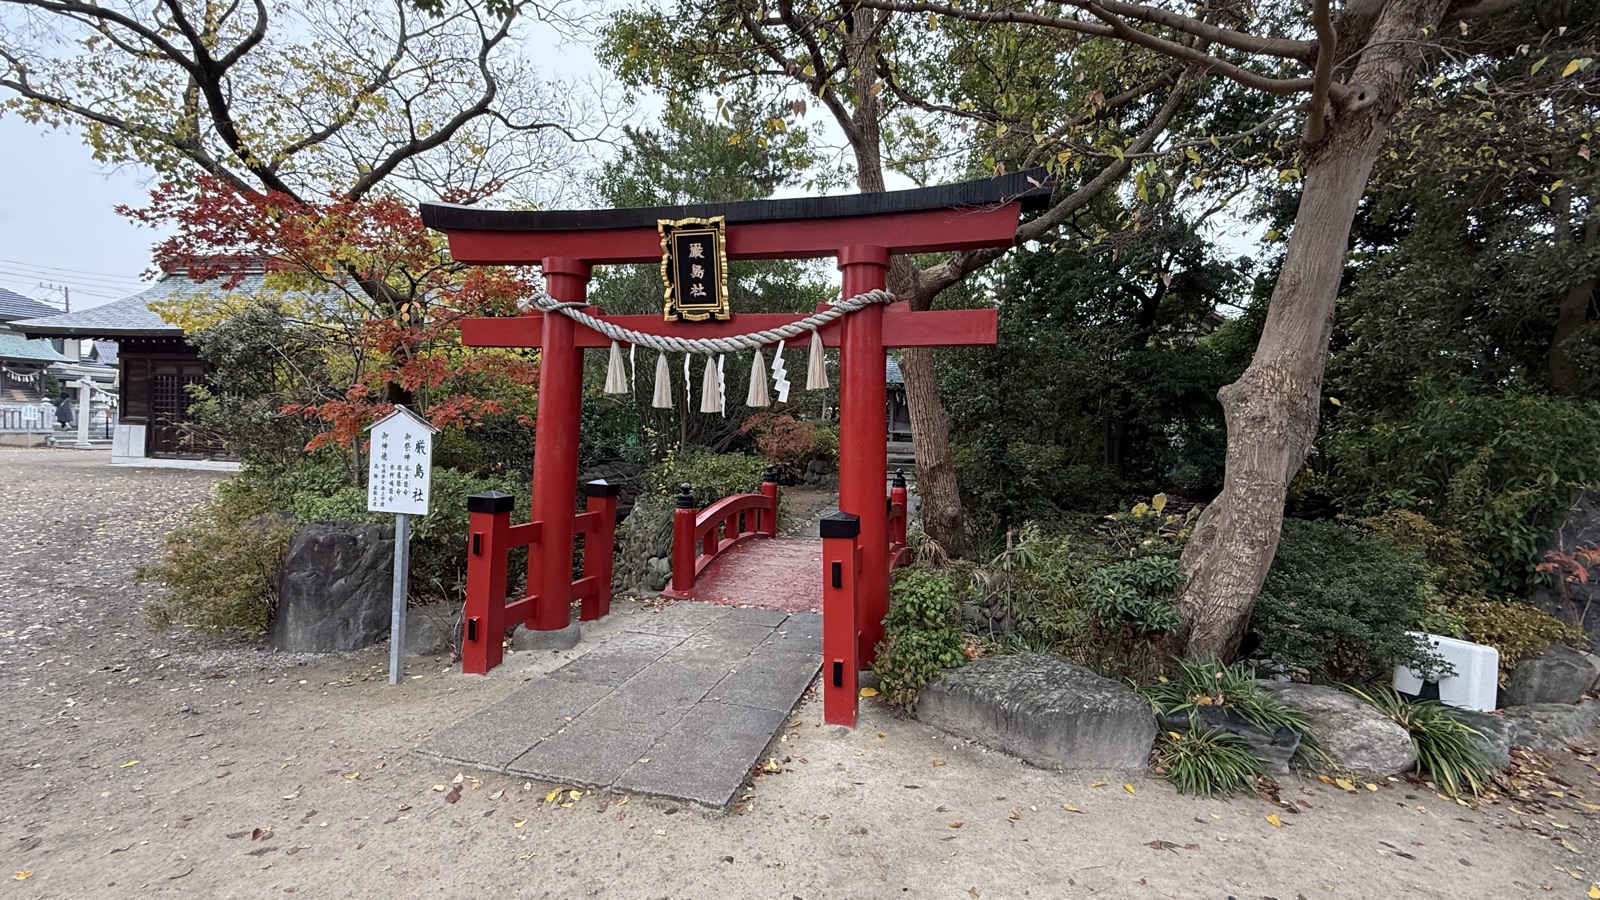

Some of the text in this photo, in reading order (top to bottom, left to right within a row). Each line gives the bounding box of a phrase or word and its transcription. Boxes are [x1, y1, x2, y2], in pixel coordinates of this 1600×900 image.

[380, 432, 388, 462] 御神徳
[404, 432, 412, 462] 御祭神
[412, 439, 427, 503] 厳島社
